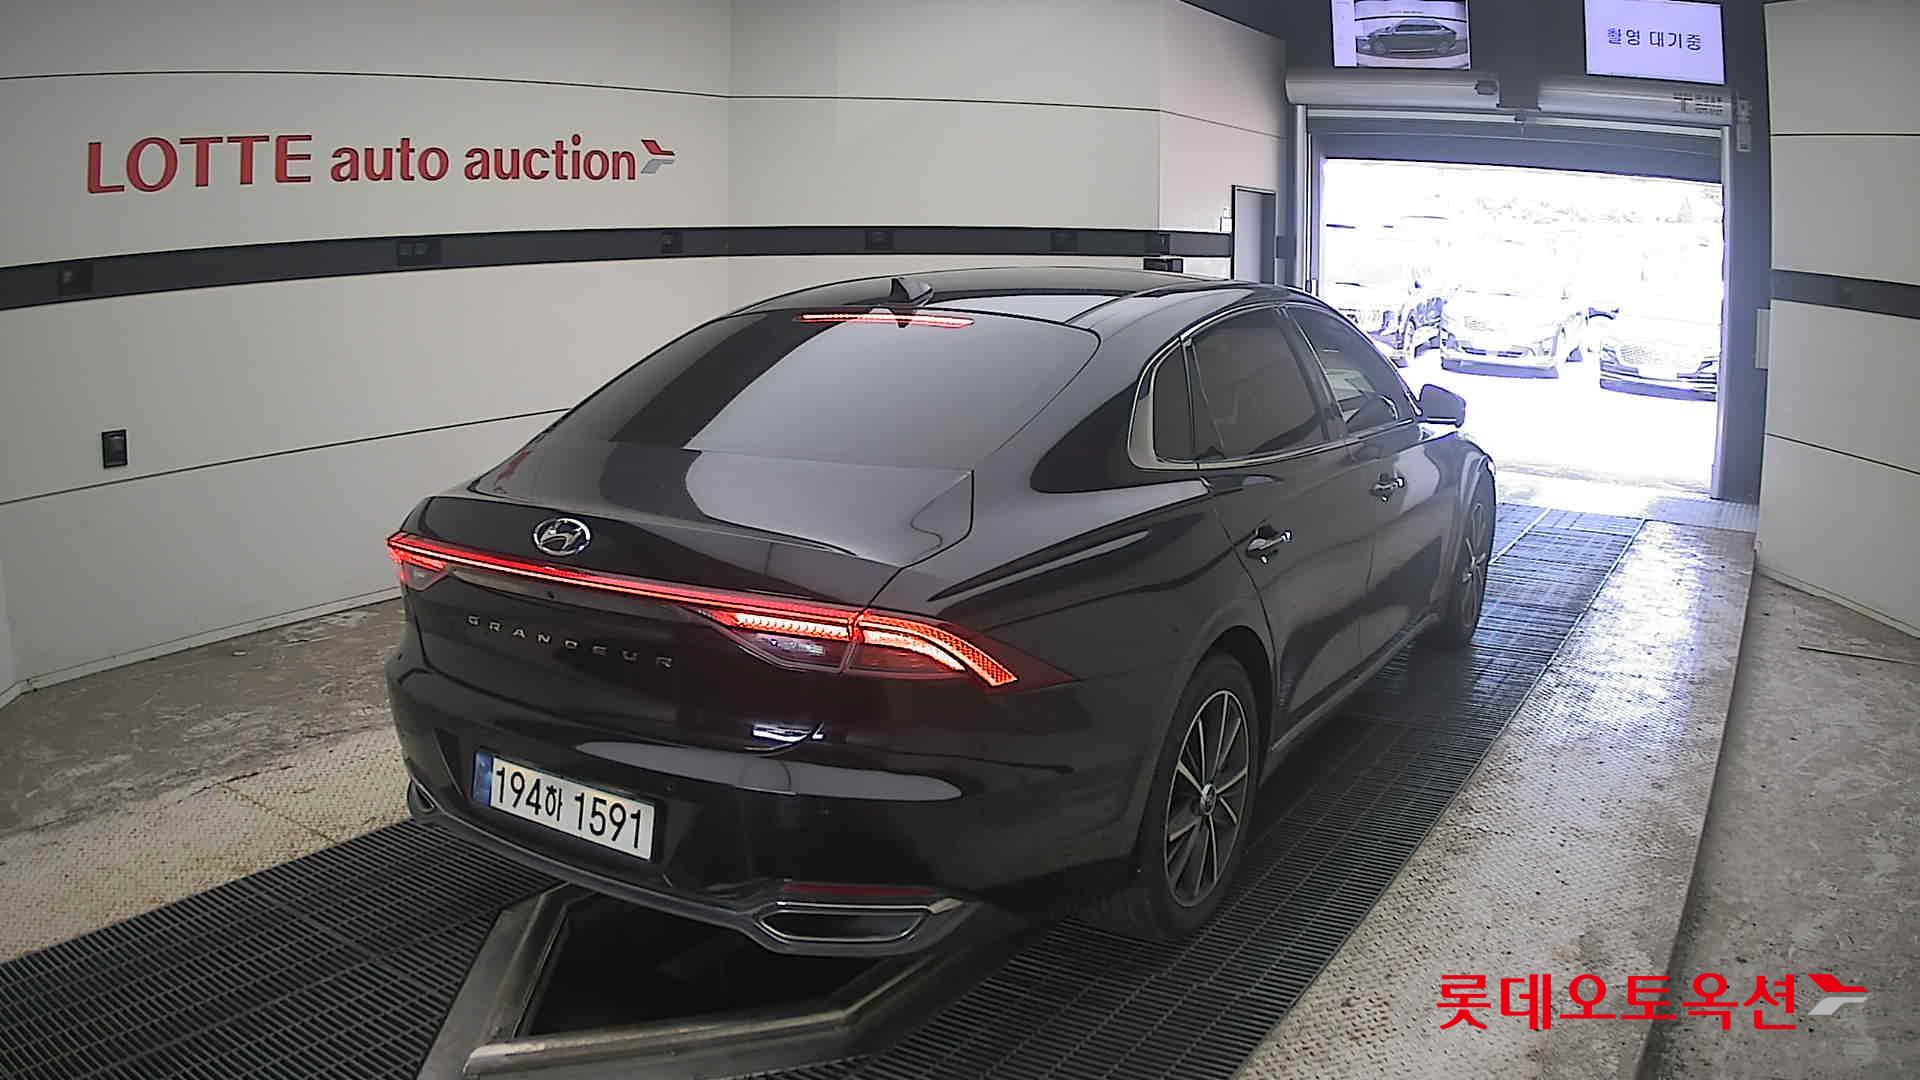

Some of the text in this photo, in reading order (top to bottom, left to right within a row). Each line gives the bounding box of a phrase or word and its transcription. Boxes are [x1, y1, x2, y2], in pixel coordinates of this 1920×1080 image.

[1649, 31, 1702, 51] 대기중
[86, 134, 637, 194] LOTTE auto auction
[468, 615, 673, 669] GRANDEUR
[496, 767, 641, 849] 194하 1591
